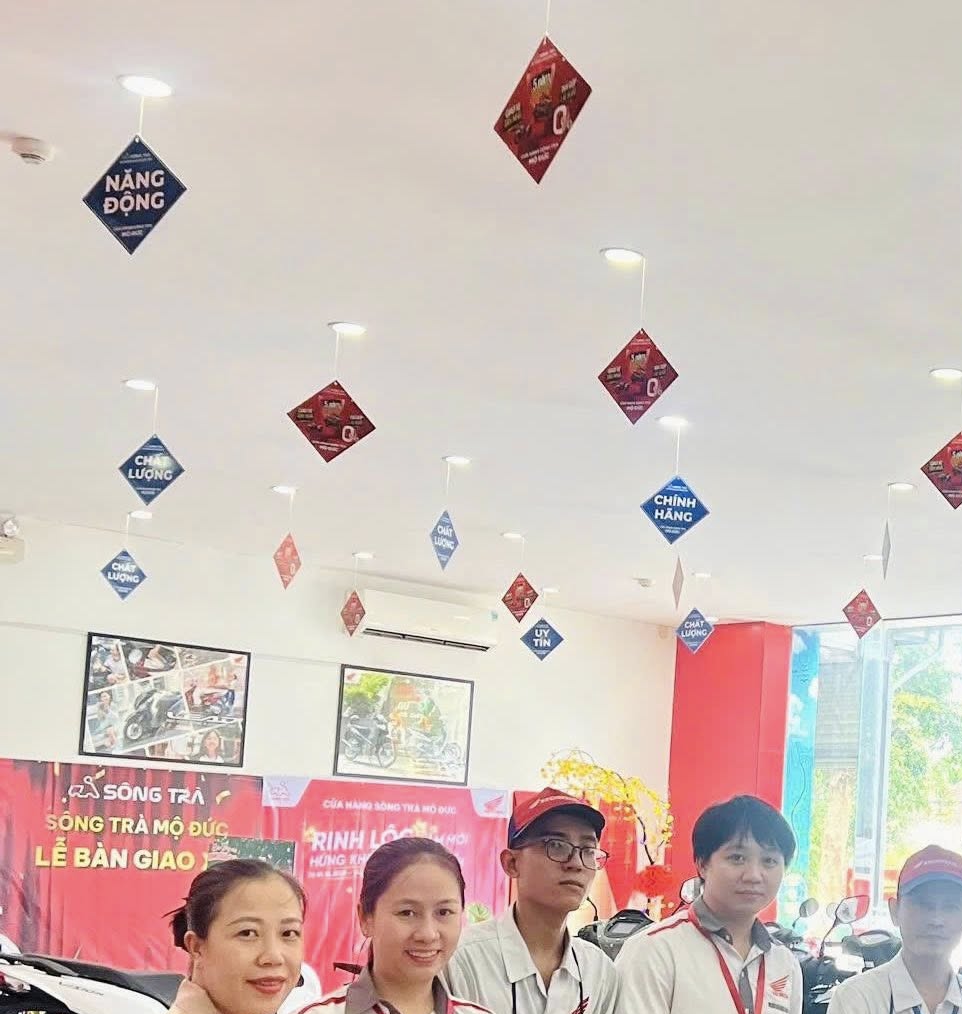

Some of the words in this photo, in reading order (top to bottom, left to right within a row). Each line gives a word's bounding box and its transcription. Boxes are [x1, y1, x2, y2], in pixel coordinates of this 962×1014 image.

[105, 168, 165, 193] NĂNG
[103, 191, 165, 217] ĐỘNG
[128, 468, 173, 482] LƯỢNG
[653, 493, 697, 509] CHÍNH
[534, 628, 550, 638] UY
[103, 781, 162, 802] SÔNG
[168, 775, 205, 805] TRÀ
[45, 810, 104, 833] SÔNG
[108, 813, 149, 835] TRÀ
[153, 815, 184, 841] MỘ
[187, 816, 229, 838] ĐỨC
[311, 829, 364, 851] RINH
[35, 836, 68, 869] LỄ
[73, 842, 129, 869] BÀN
[133, 849, 196, 871] GIAO
